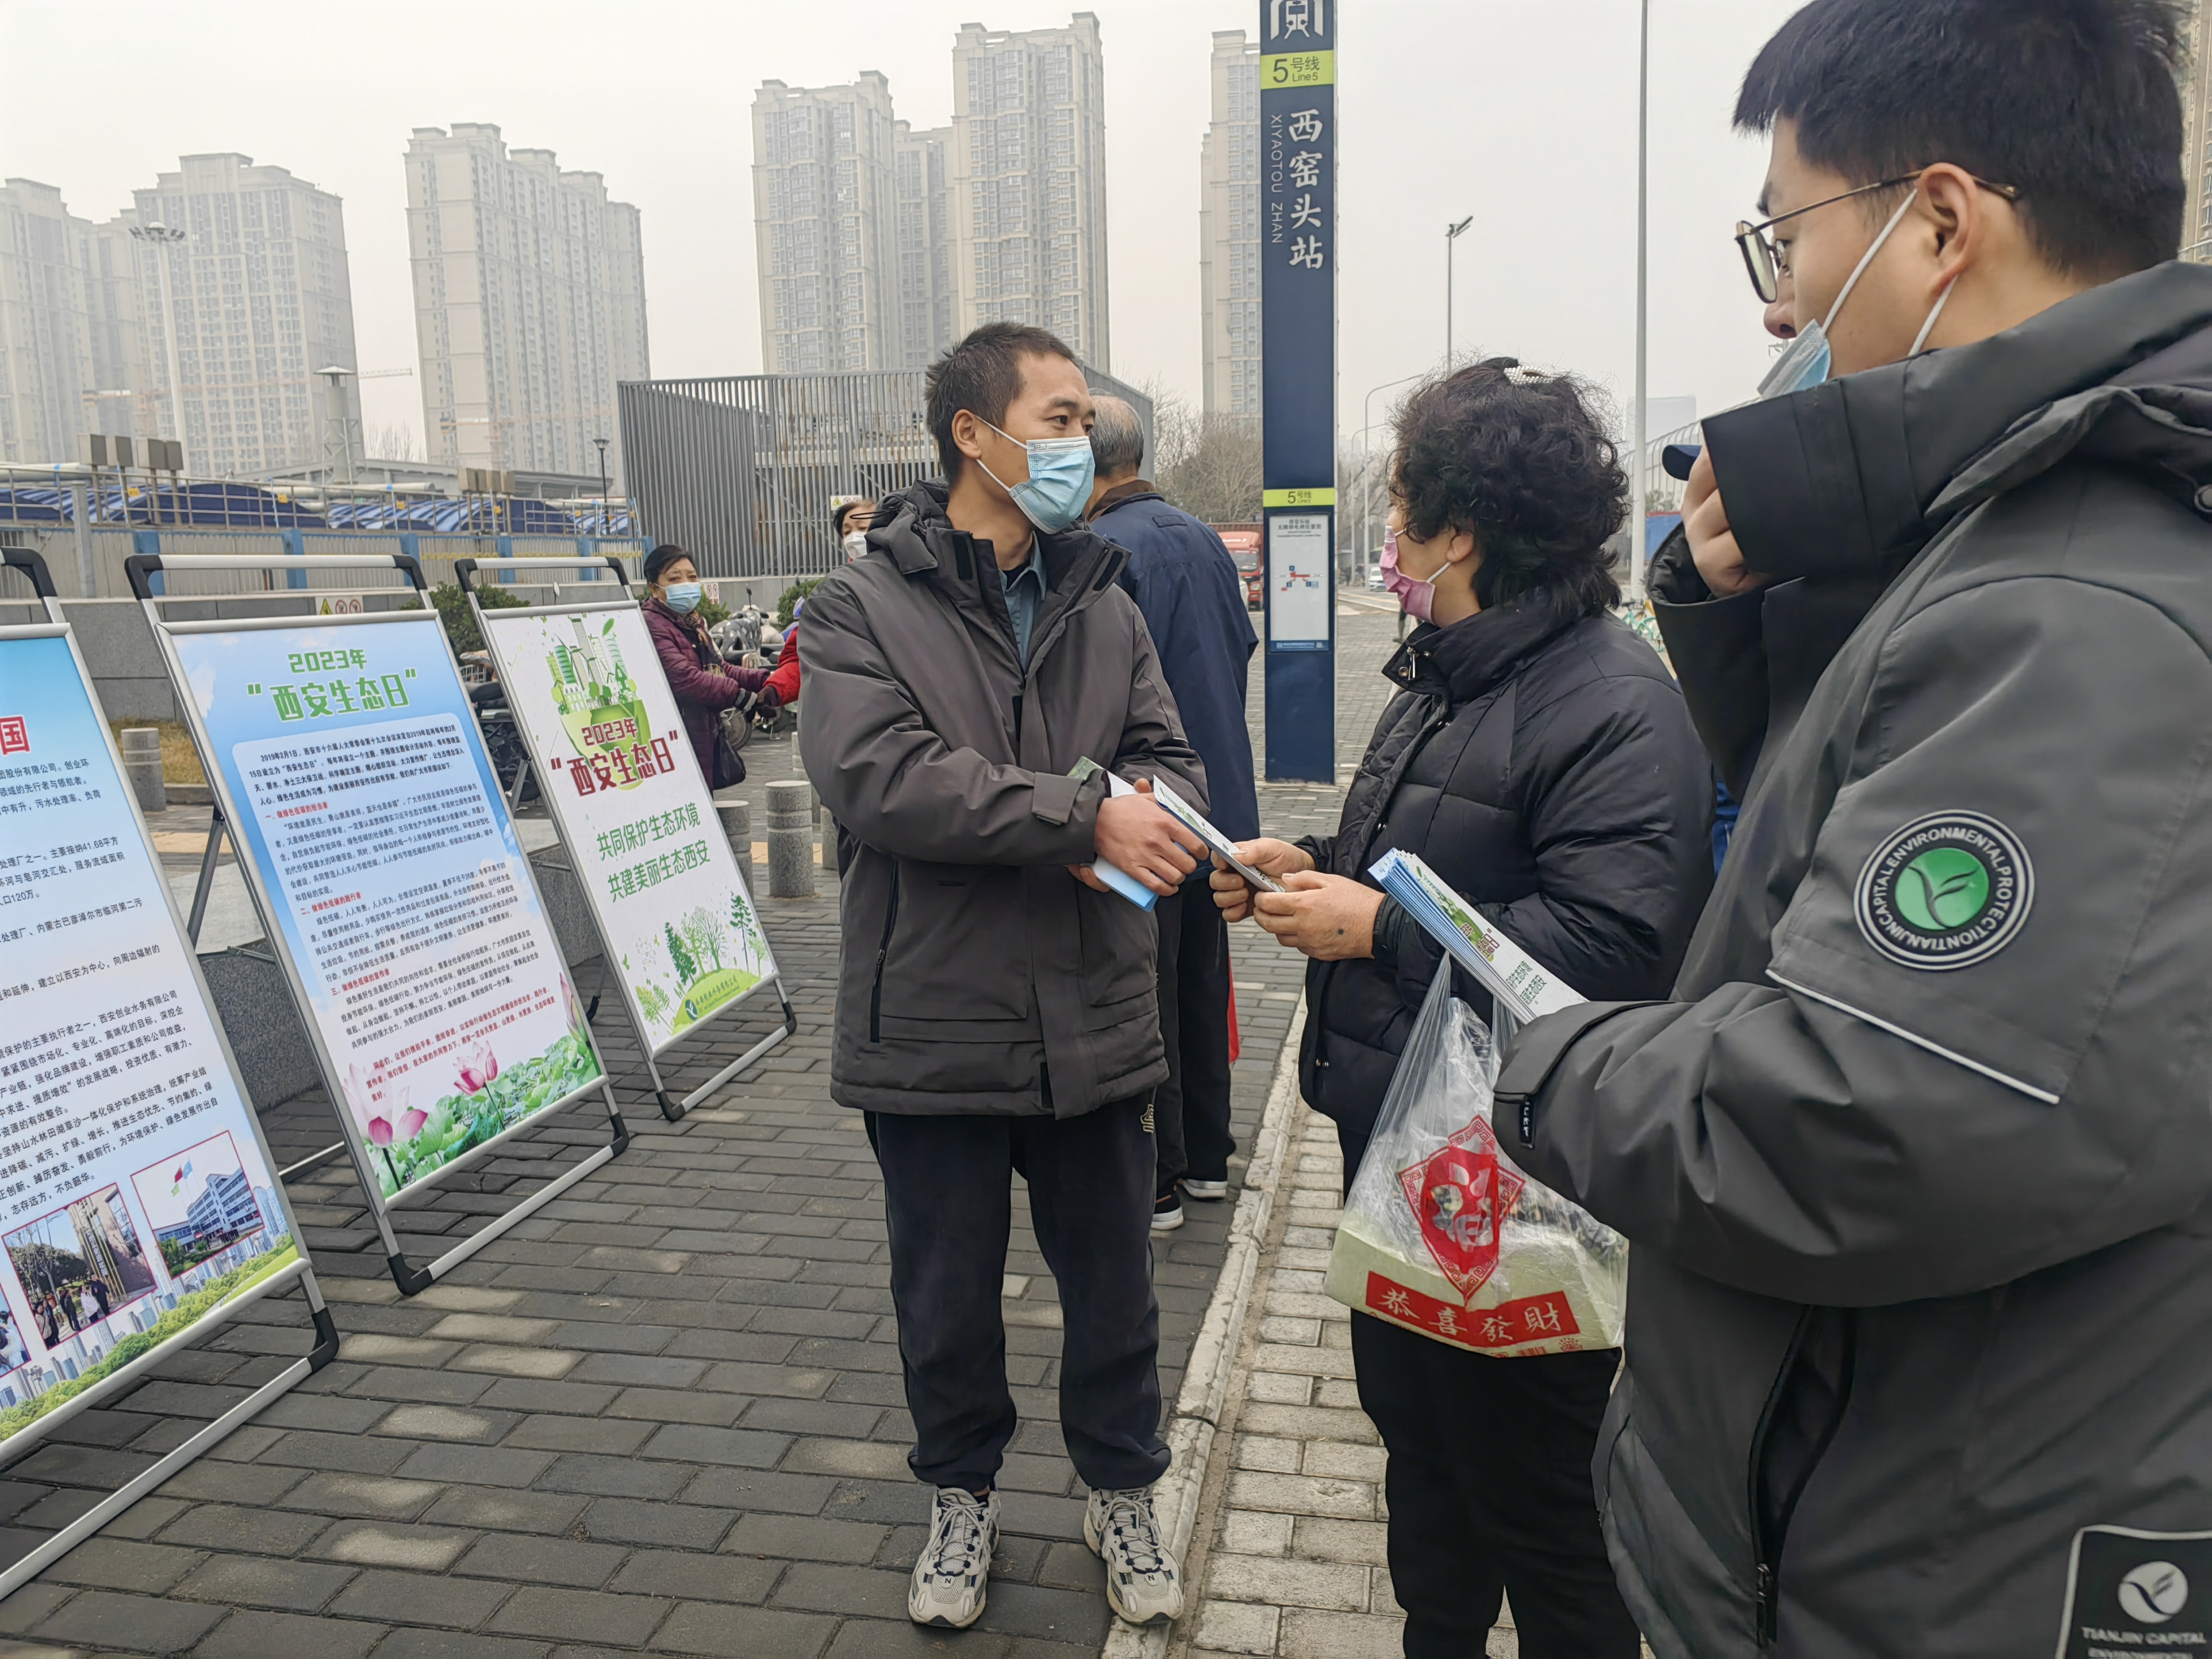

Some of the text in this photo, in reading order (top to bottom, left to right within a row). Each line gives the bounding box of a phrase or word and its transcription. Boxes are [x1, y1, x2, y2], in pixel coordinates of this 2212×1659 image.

[1270, 114, 1284, 244] XIYAOTOU ZHAN
[1289, 109, 1324, 269] 西窑头站
[288, 649, 367, 673] 2023年
[0, 716, 30, 755] 国
[582, 717, 638, 746] 2023年
[0, 789, 103, 815] 中有升，污水处理率、负荷
[596, 801, 701, 860] 共同保护生态环境
[1886, 827, 2006, 868] ENVIRONMENTAL
[607, 838, 711, 903] 共建美丽生态西安
[0, 888, 42, 907] 口120万。
[0, 896, 144, 945] 处理厂、内蒙古巴彦淖尔市临河第二污
[1945, 866, 2013, 950] PROTECTION
[0, 1102, 71, 1140] 资源的有效整合。
[0, 1169, 96, 1223] ，志存远方，不负韶华。
[1378, 1287, 1561, 1342] 恭喜發財
